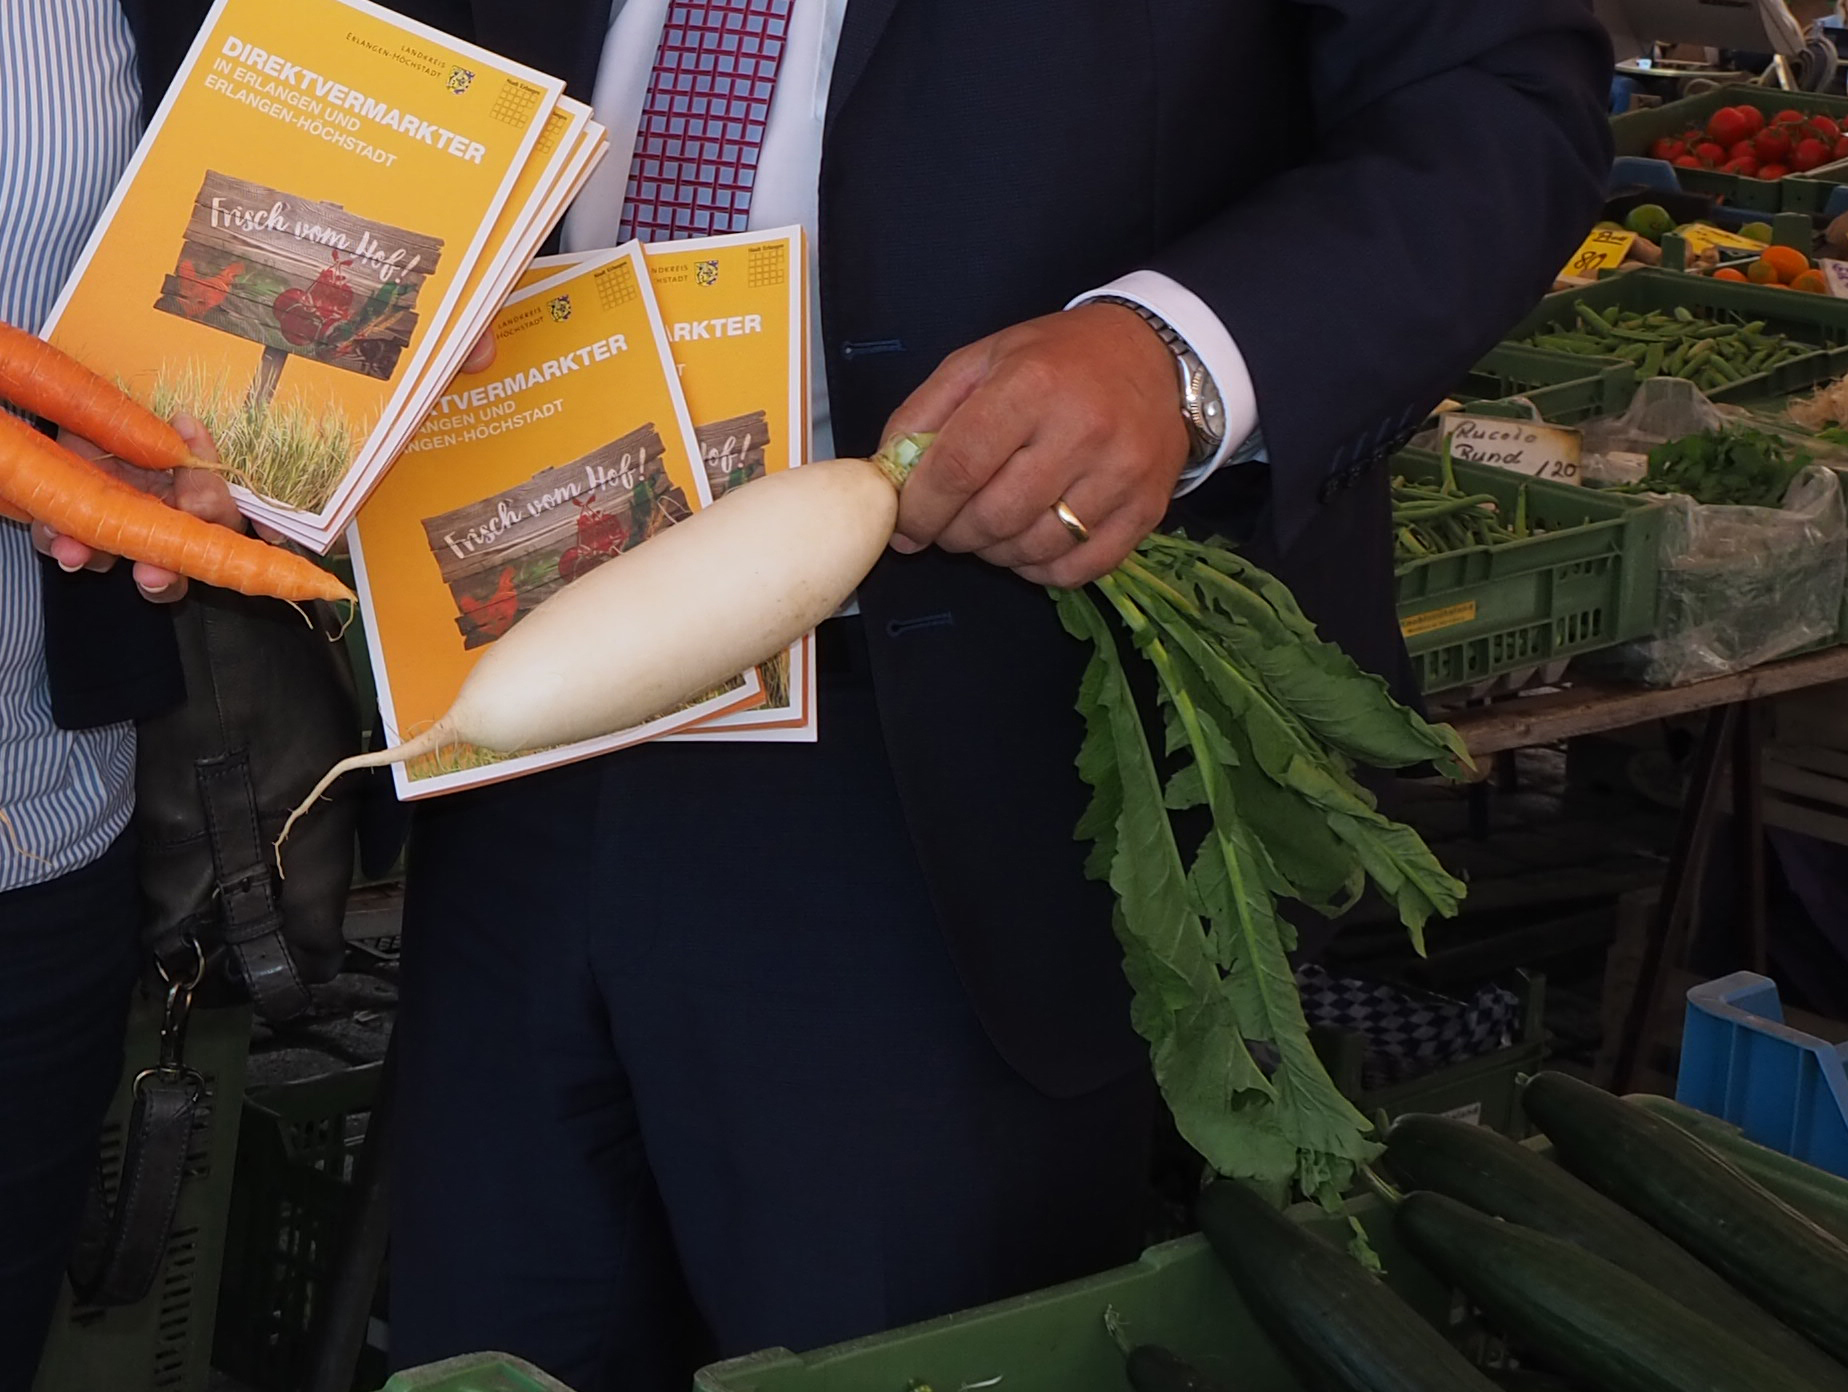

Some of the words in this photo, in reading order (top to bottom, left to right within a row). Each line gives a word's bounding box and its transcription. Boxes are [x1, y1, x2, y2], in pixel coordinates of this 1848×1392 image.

[214, 57, 231, 75] IN
[233, 66, 322, 115] ERLANGEN
[324, 108, 361, 132] UND
[401, 45, 446, 69] LANDKREIS
[204, 75, 398, 168] ERLANGEN-HÖCHSTADT
[221, 35, 487, 164] DIREKTVERMARKTER
[211, 197, 289, 232] Frisch
[294, 220, 350, 250] vom
[349, 231, 421, 284] Hof!
[498, 308, 542, 330] LANDKREIS
[431, 333, 628, 416] TVERMARKTER
[479, 400, 516, 421] UND
[404, 398, 564, 454] NGEN-HÖCHSTADT
[444, 498, 523, 558] Frisch
[527, 481, 585, 517] vom
[585, 447, 646, 490] Hof!
